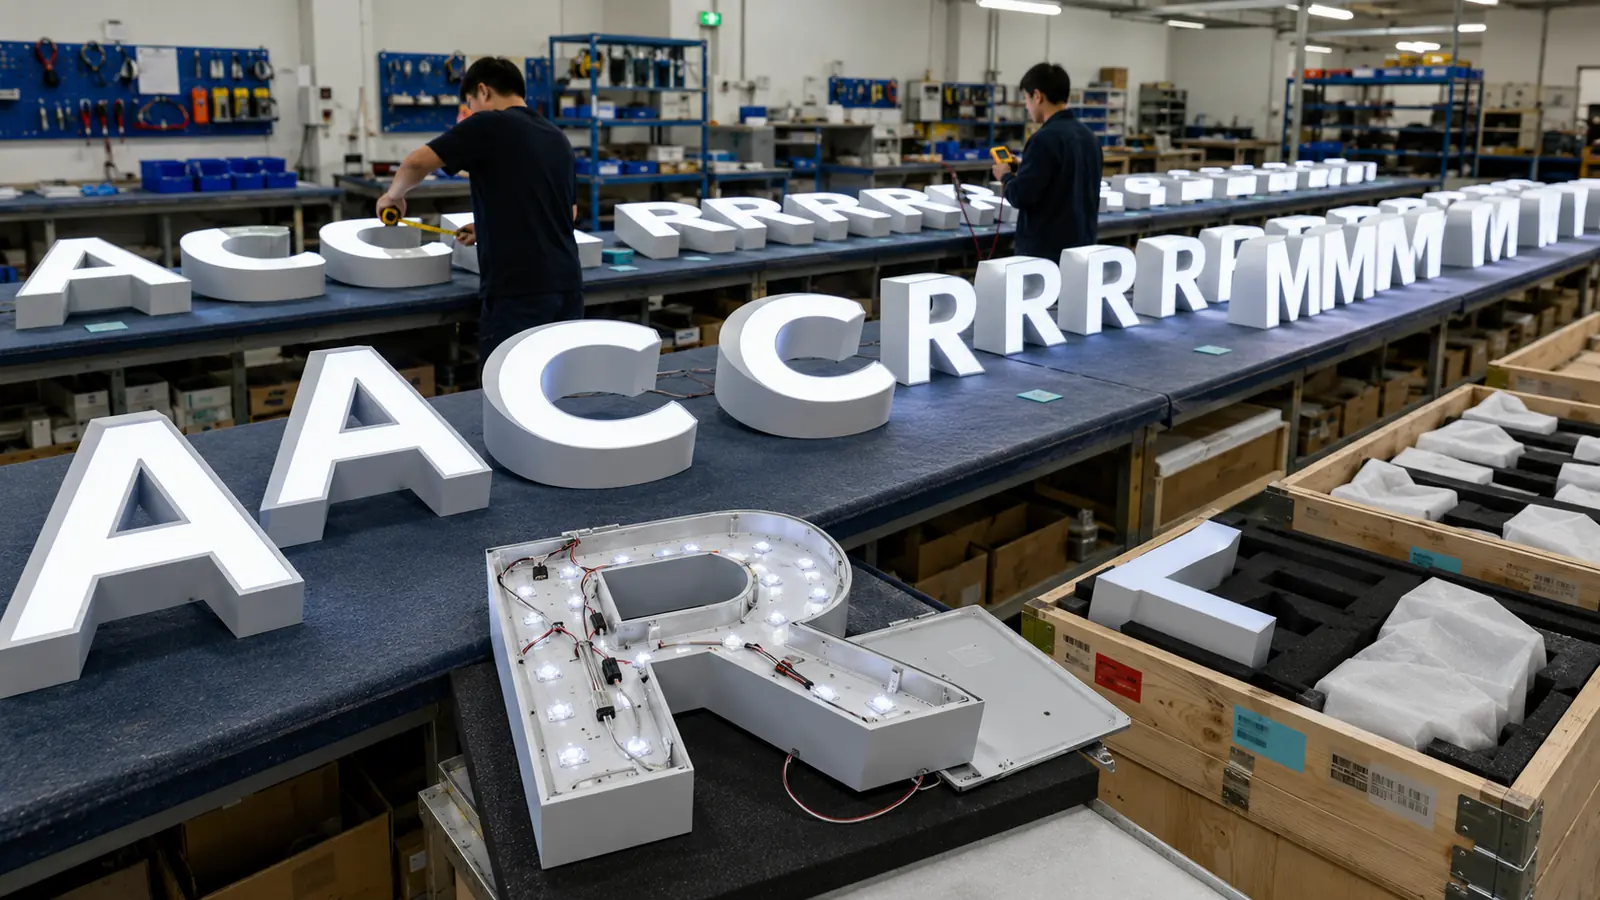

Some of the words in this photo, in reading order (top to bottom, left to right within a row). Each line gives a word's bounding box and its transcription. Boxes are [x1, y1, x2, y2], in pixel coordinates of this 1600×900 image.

[16, 237, 191, 298] A
[180, 225, 326, 272] C
[319, 217, 452, 262] C
[615, 202, 737, 239] R
[702, 197, 815, 231] R
[783, 193, 892, 224] R
[859, 188, 962, 217] R
[1, 412, 304, 650] A
[262, 346, 491, 510] A
[488, 320, 698, 449] C
[730, 293, 896, 402] C
[905, 274, 985, 386] R
[1004, 257, 1067, 355] R
[1085, 245, 1140, 335] R
[1159, 235, 1208, 318] R
[1265, 236, 1321, 329] M
[1320, 224, 1376, 312] M
[486, 510, 984, 812] R
